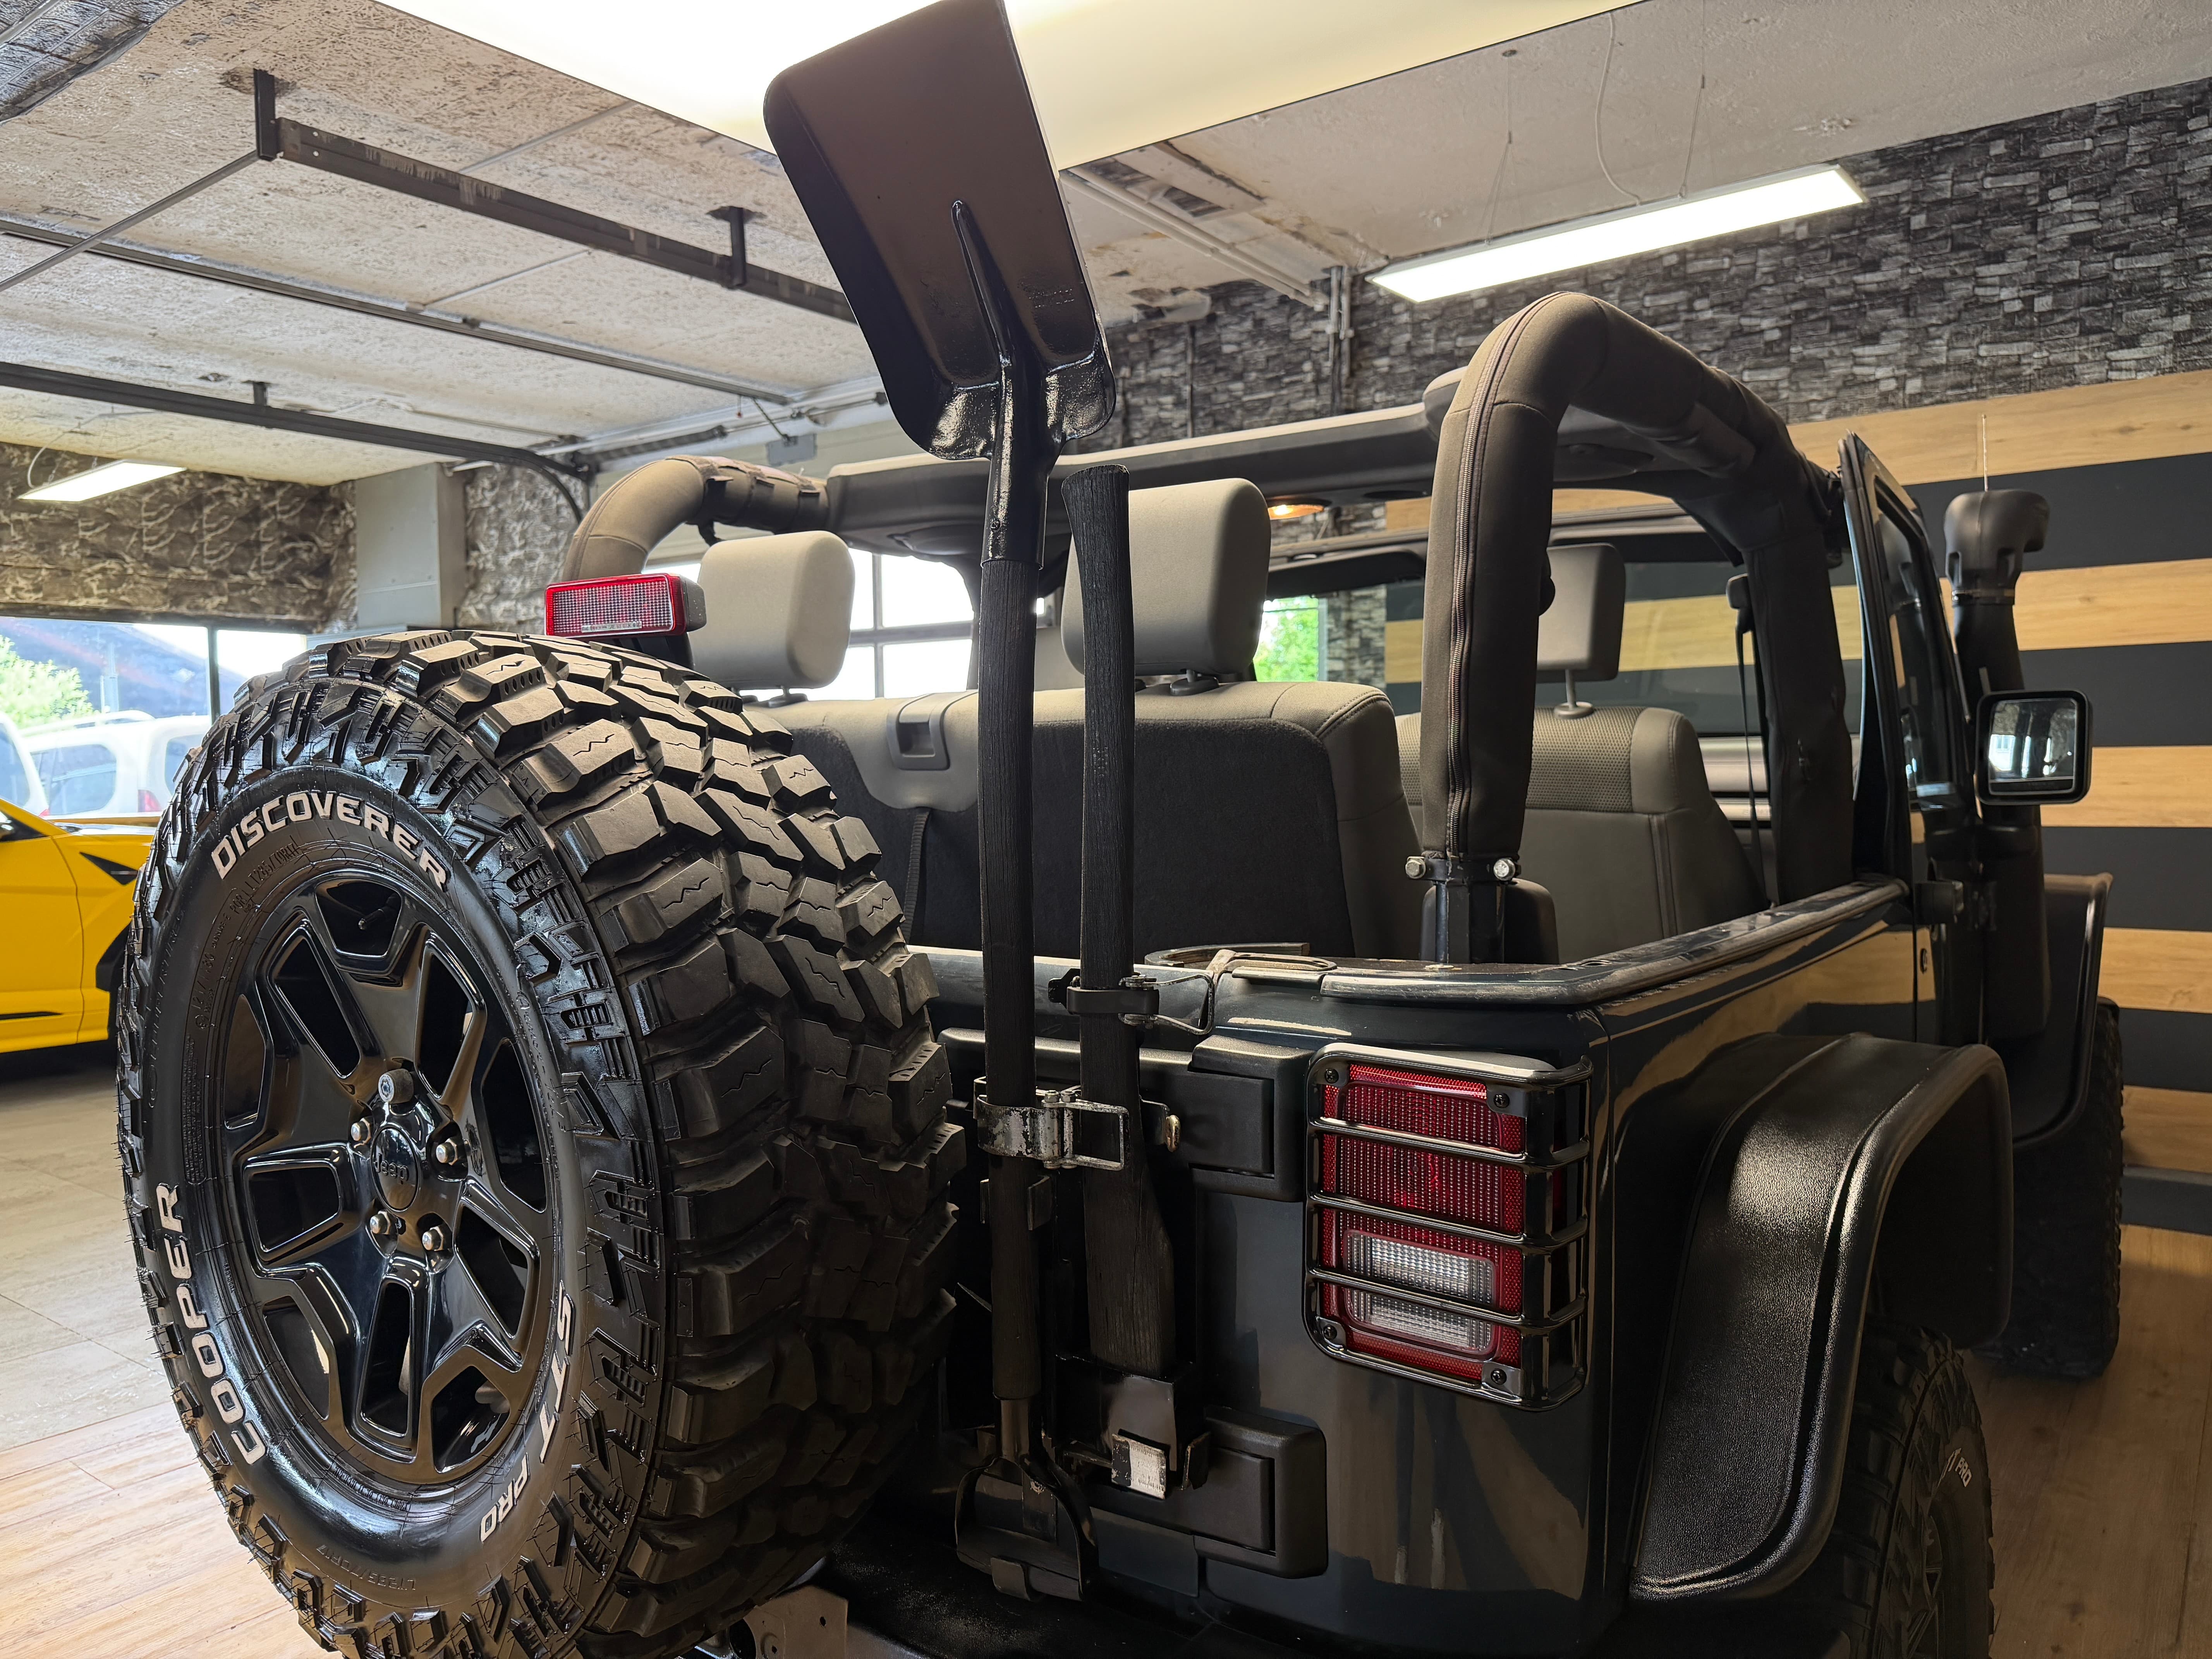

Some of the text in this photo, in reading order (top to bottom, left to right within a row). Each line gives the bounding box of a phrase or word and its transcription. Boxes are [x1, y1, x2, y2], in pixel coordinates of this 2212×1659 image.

[211, 790, 447, 891] DISCOVERER
[373, 1152, 410, 1185] Jeep
[156, 1183, 266, 1464] COOPER
[539, 1281, 573, 1463] STT
[480, 1453, 529, 1542] PRO
[1955, 1457, 1972, 1487] PRO
[316, 1545, 417, 1591] LT285/70R17
